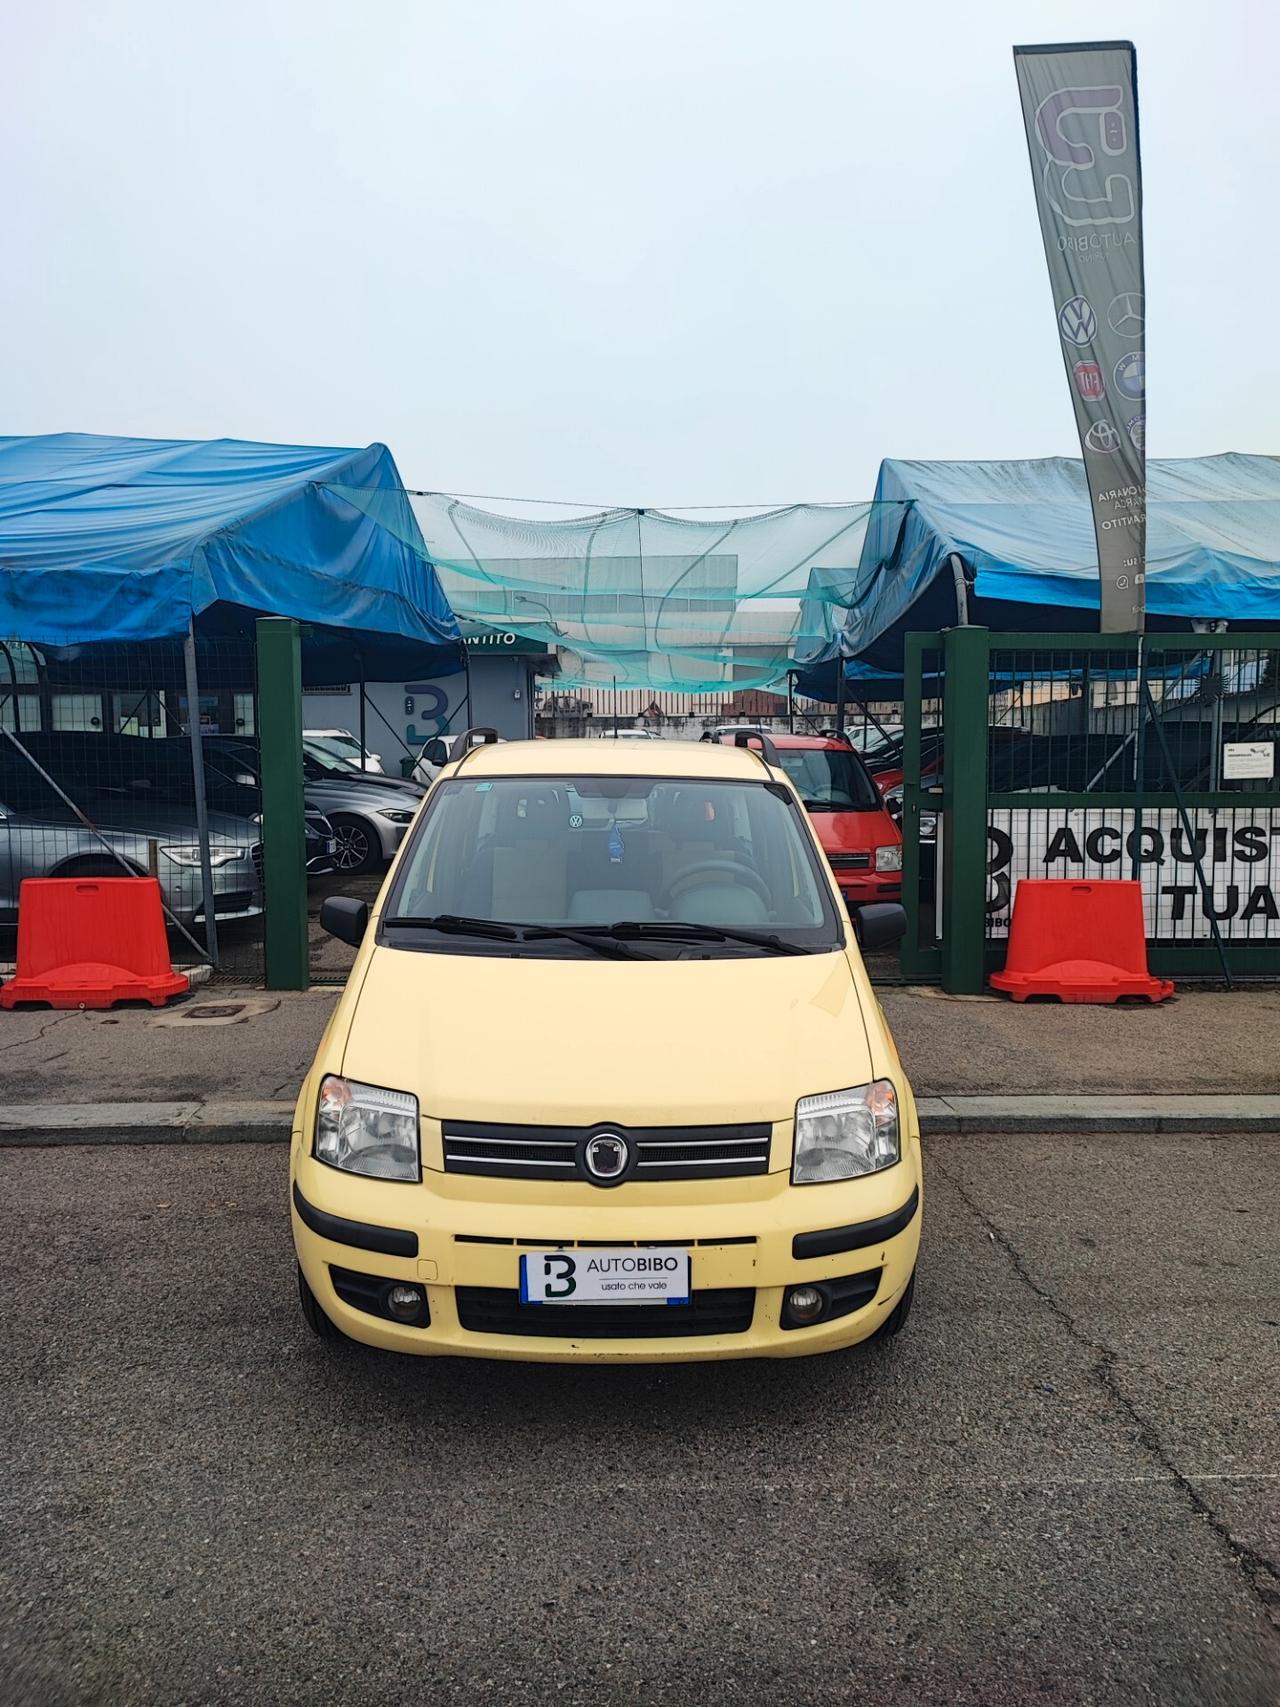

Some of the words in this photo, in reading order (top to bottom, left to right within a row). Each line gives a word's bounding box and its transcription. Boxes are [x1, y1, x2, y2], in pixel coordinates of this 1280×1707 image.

[1161, 885, 1280, 921] TUA
[587, 1257, 678, 1273] AUTOBIBO
[601, 1281, 626, 1291] usato
[628, 1281, 646, 1291] che
[648, 1281, 667, 1290] vale
